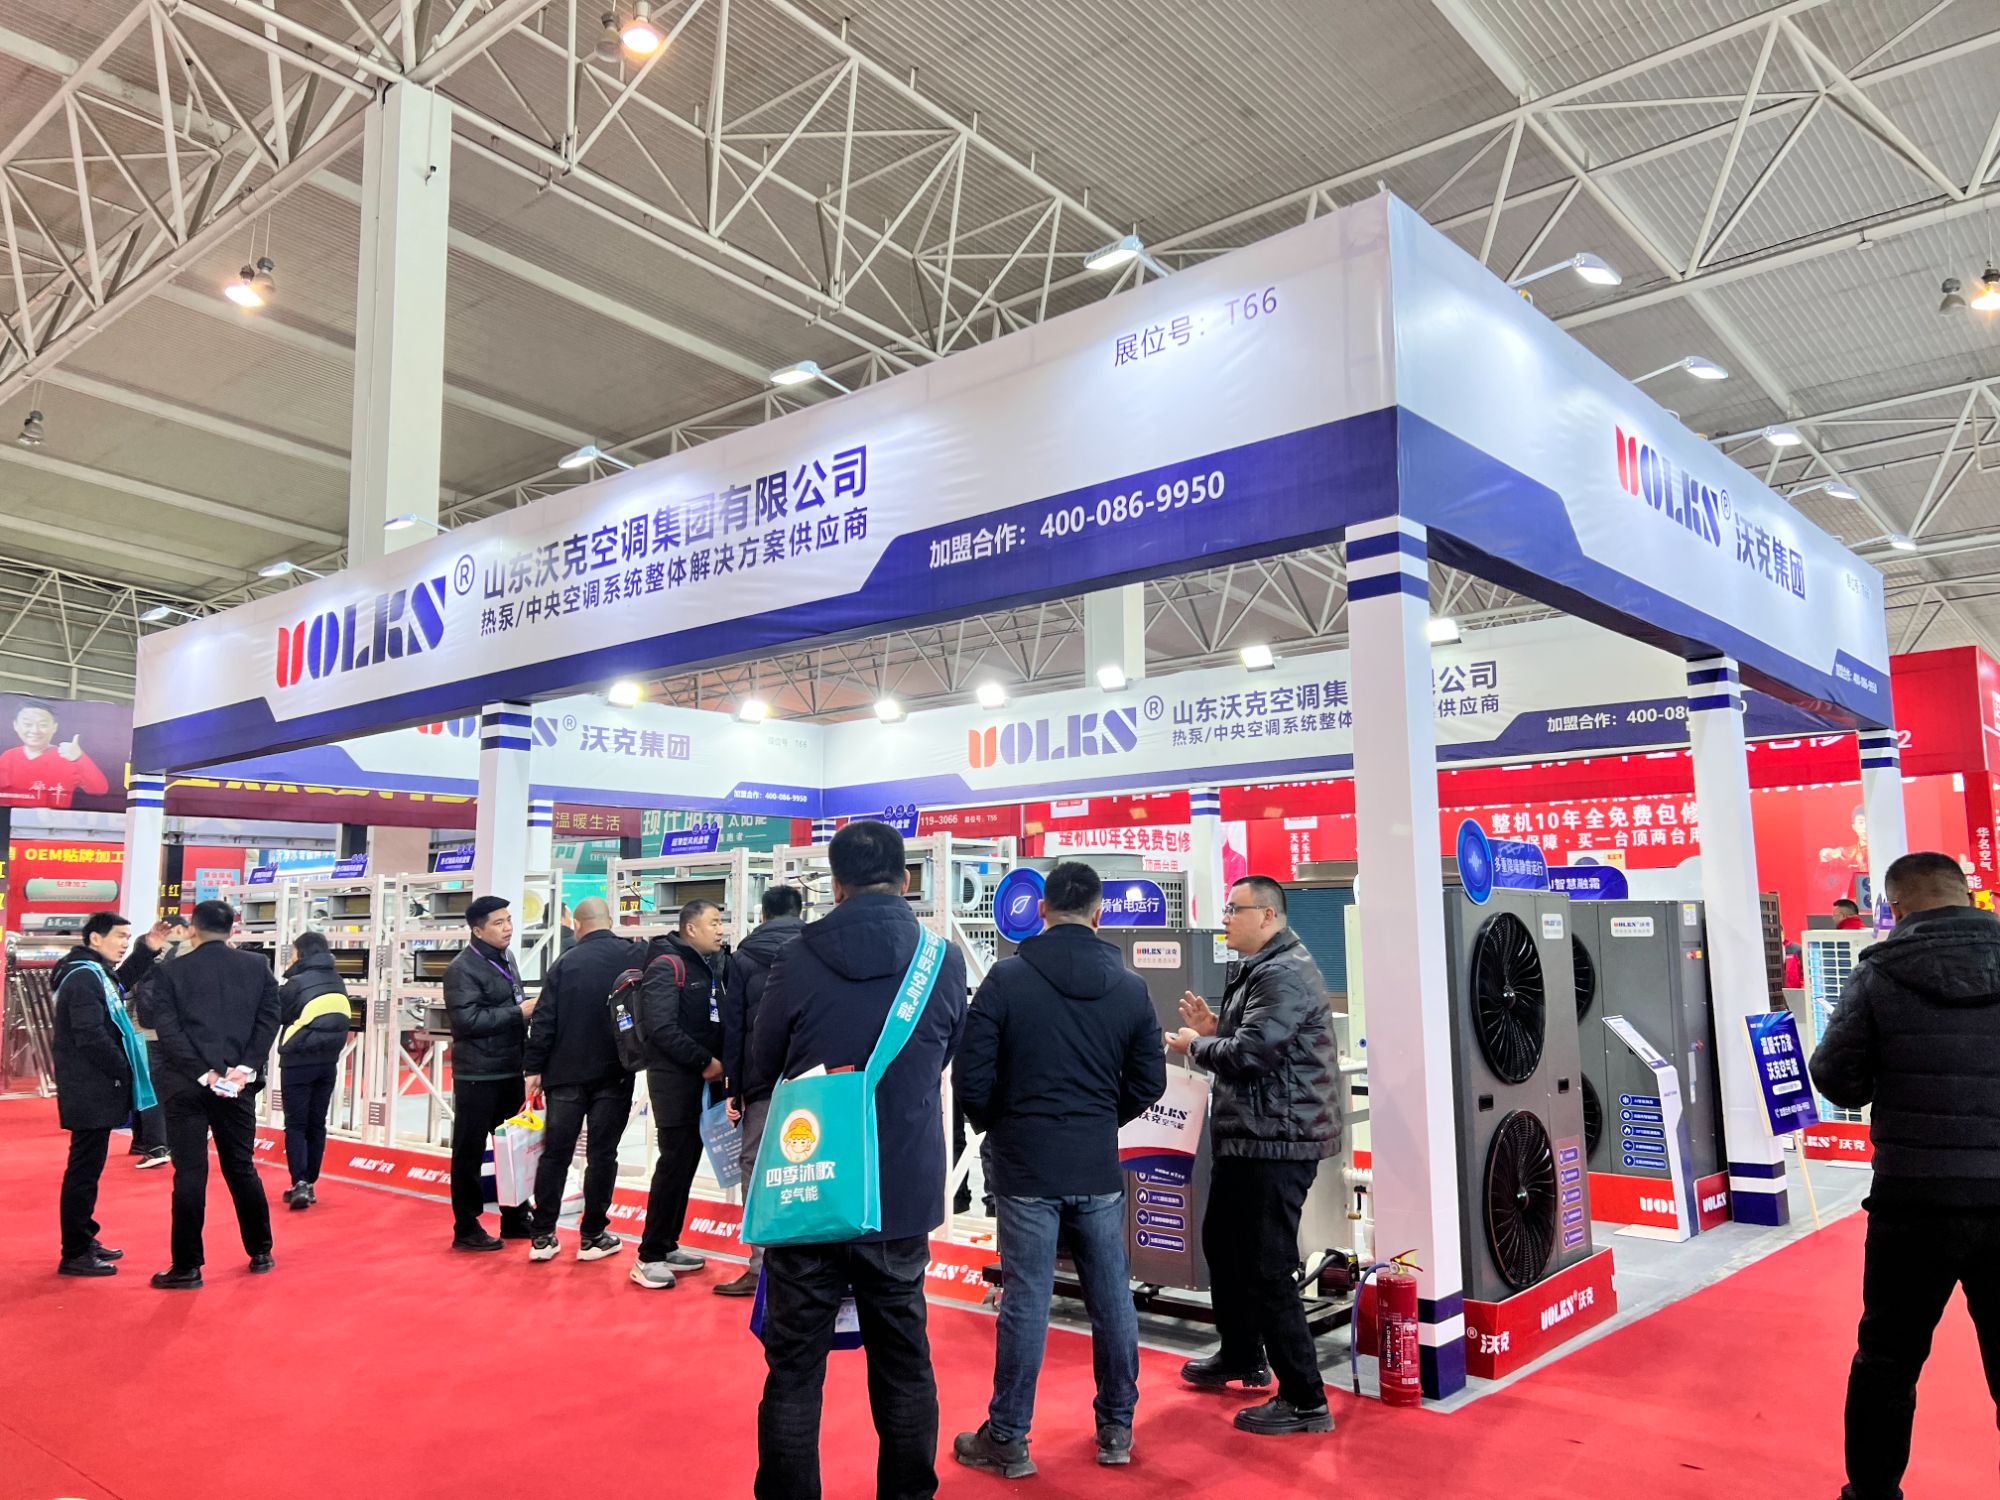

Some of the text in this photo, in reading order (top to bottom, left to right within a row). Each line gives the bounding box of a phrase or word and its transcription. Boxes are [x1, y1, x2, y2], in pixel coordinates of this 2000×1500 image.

[1224, 287, 1277, 326] T66
[1040, 470, 1225, 539] 400-086-9950
[484, 445, 867, 600] 山东沃克空调集团有限公司
[1735, 512, 1806, 601] 沃克集团
[480, 506, 868, 636] 热泵/中央空调系统整体解决方案供应商
[1626, 705, 1689, 724] 400-08
[579, 724, 691, 761] 沃克集团
[556, 812, 621, 832] 温暖生活
[1491, 802, 1700, 834] 整机10年全免费包修
[1058, 828, 1191, 852] 整机10年全免费包修
[25, 848, 125, 863] OEM贴牌加工
[1839, 1138, 1866, 1151] 沃克
[765, 1160, 837, 1188] 四季沐歌
[780, 1186, 819, 1205] 空气能
[1577, 1287, 1594, 1311] 沃克
[1479, 1331, 1510, 1355] 沃克
